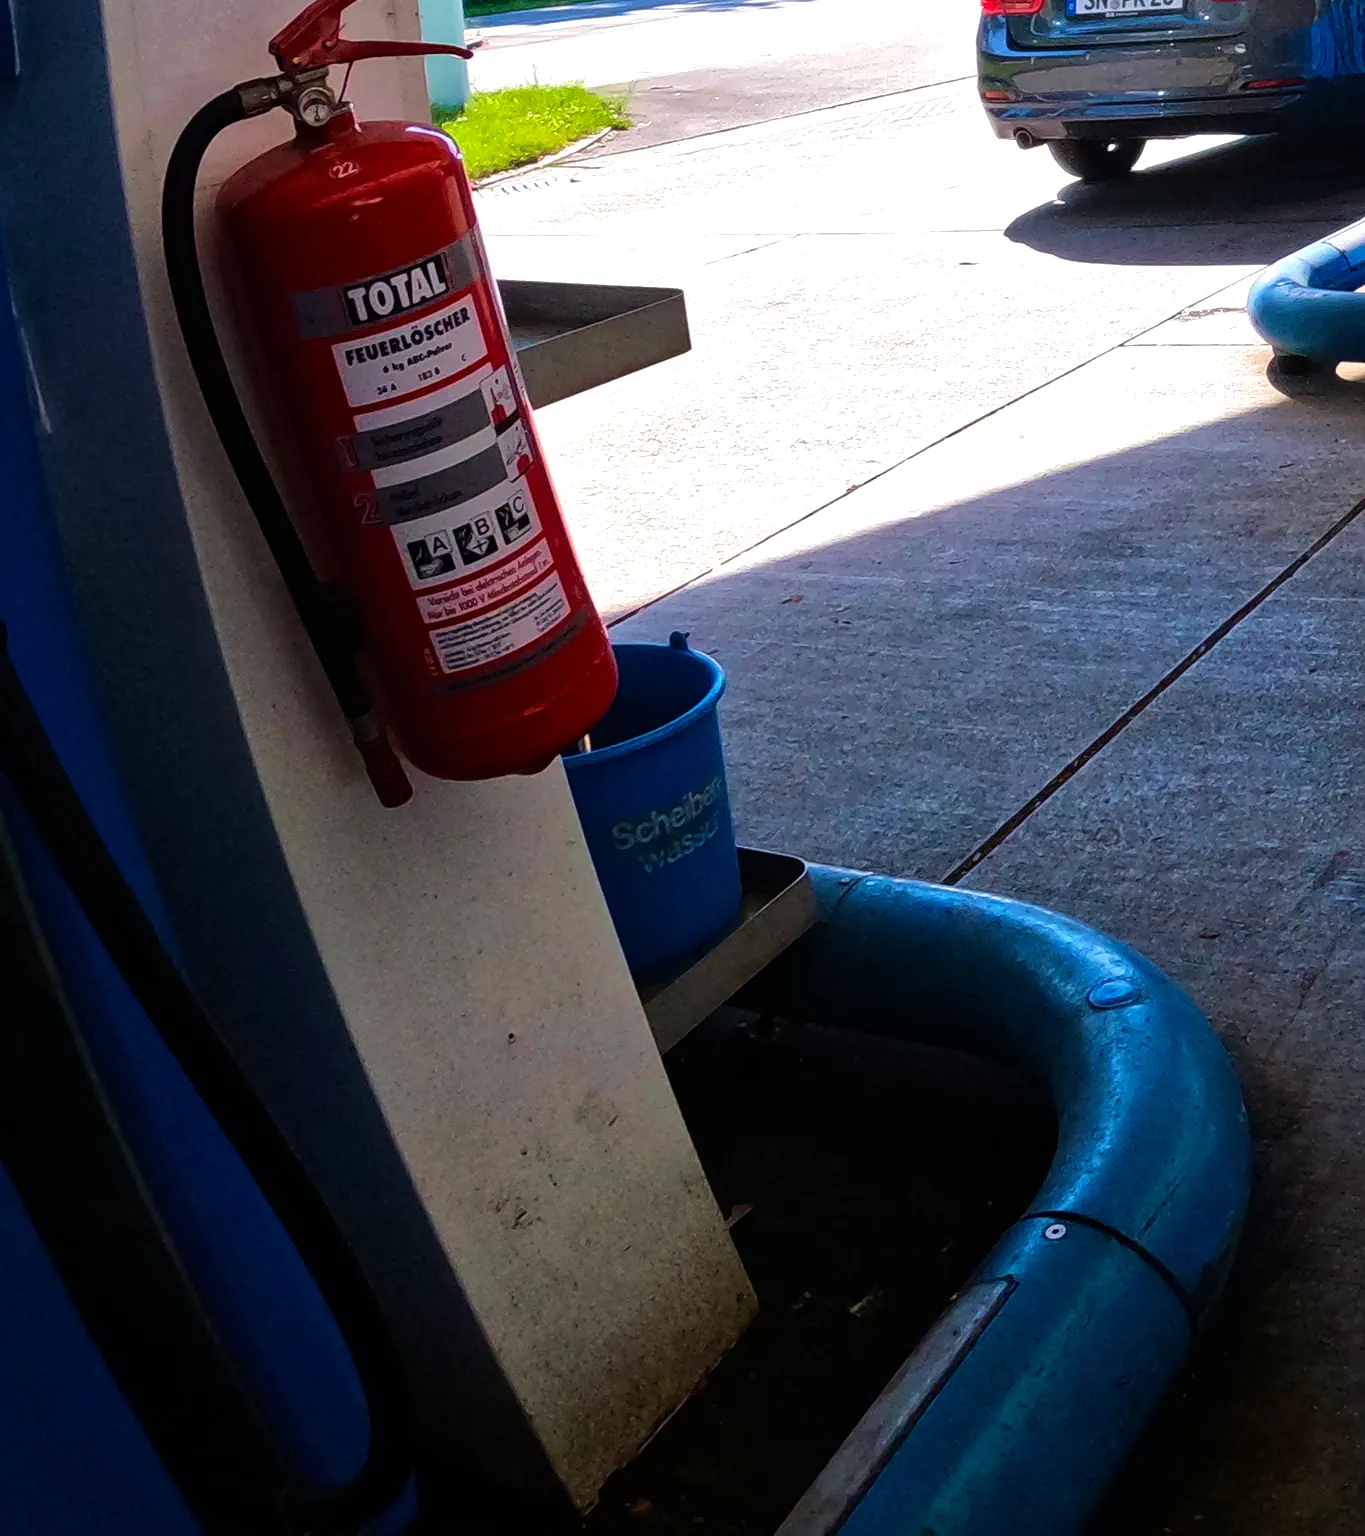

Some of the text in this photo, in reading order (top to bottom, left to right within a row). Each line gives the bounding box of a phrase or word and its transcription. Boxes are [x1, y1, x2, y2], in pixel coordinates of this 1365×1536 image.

[333, 162, 357, 178] 22
[347, 261, 446, 321] TOTAL
[345, 307, 471, 366] FEUERLÖSCHER
[383, 365, 389, 374] 6
[393, 360, 405, 372] kg
[390, 383, 397, 392] A
[512, 495, 526, 514] C
[475, 517, 491, 536] B
[432, 536, 449, 554] A
